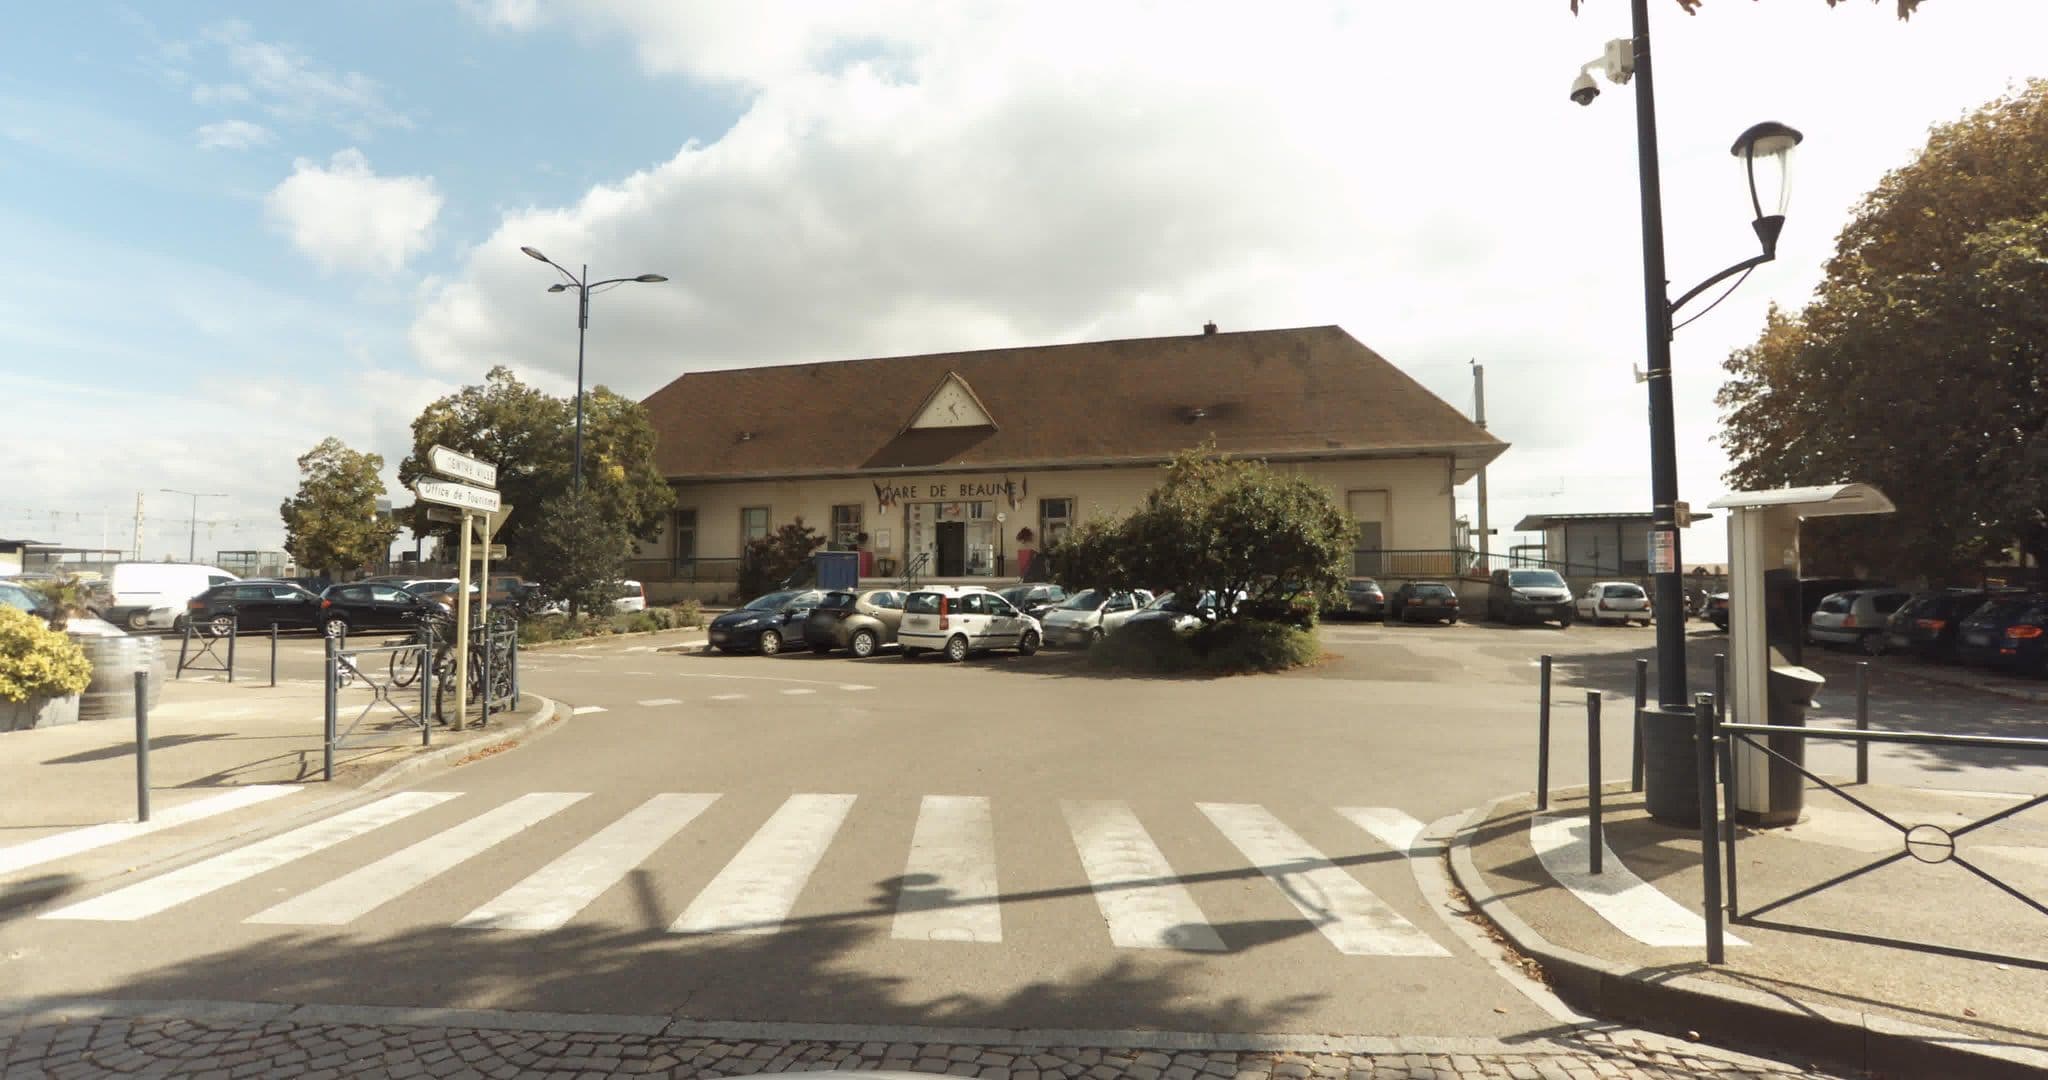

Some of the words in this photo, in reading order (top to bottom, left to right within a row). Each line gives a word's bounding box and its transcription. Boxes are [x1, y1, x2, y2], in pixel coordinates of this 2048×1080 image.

[426, 483, 449, 498] Office
[453, 488, 463, 501] de
[467, 491, 497, 508] Tourisme
[930, 484, 947, 497] DE
[960, 482, 1016, 497] BEAUNE
